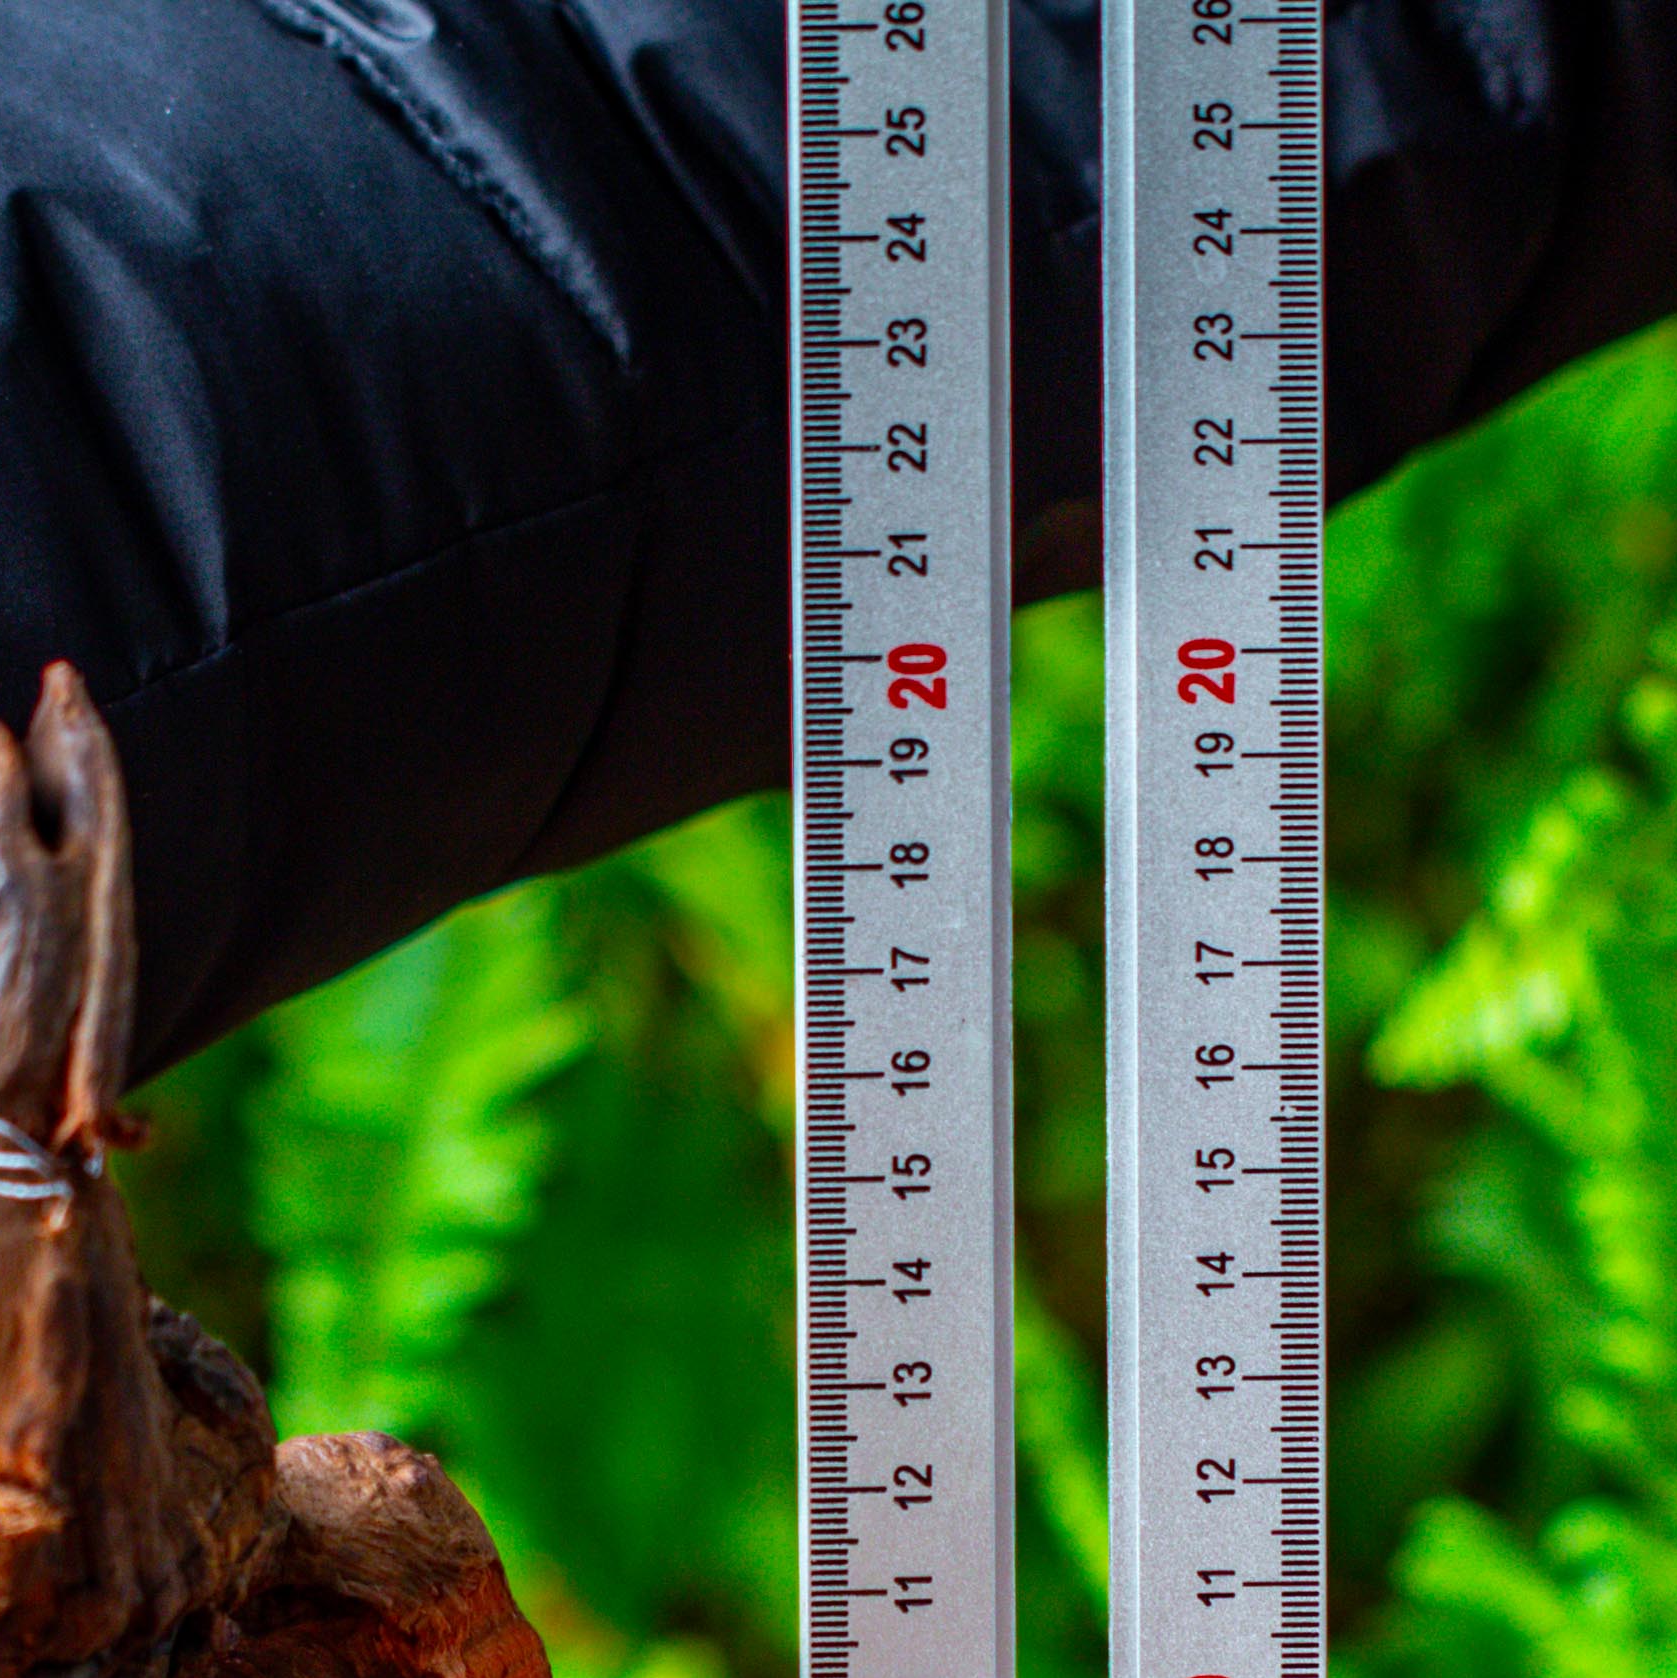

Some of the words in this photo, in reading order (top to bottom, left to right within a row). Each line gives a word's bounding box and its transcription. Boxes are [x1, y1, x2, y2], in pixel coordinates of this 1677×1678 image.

[884, 2, 925, 51] 26
[1192, 0, 1232, 45] 26
[886, 107, 926, 157] 25
[1193, 102, 1233, 150] 25
[886, 213, 926, 262] 24
[1193, 208, 1233, 256] 24
[886, 318, 927, 367] 23
[1194, 313, 1233, 361] 23
[887, 424, 927, 472] 22
[1194, 419, 1233, 466] 22
[887, 534, 927, 577] 21
[1194, 529, 1233, 570] 21
[887, 643, 947, 709] 20
[1178, 638, 1235, 704] 20
[889, 738, 929, 784] 19
[1195, 732, 1234, 777] 19
[890, 842, 929, 889] 18
[1195, 837, 1234, 881] 18
[891, 947, 930, 992] 17
[1195, 941, 1234, 985] 17
[891, 1050, 930, 1096] 16
[1195, 1044, 1234, 1089] 16
[892, 1154, 931, 1200] 15
[1196, 1148, 1235, 1193] 15
[893, 1258, 931, 1304] 14
[1196, 1252, 1235, 1297] 14
[893, 1361, 932, 1407] 13
[1196, 1355, 1235, 1400] 13
[893, 1465, 932, 1510] 12
[1197, 1459, 1235, 1503] 12
[894, 1576, 933, 1613] 11
[1197, 1570, 1235, 1606] 11
